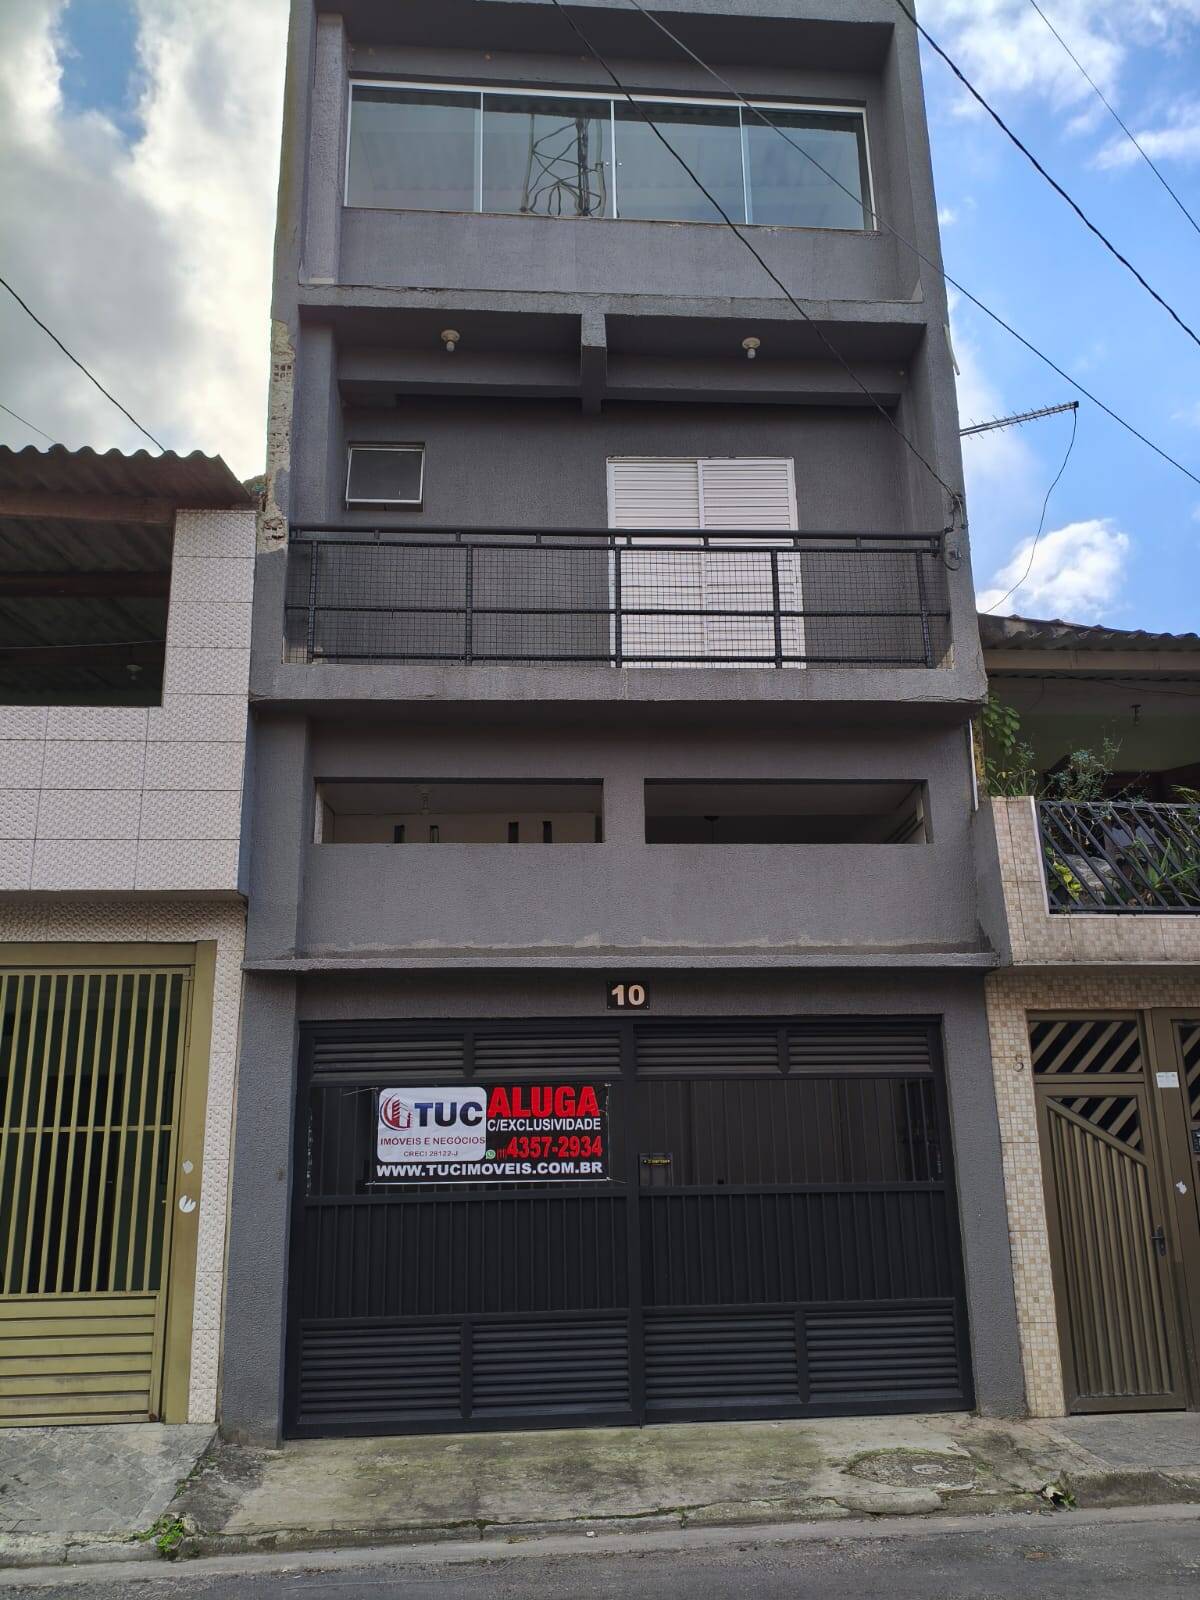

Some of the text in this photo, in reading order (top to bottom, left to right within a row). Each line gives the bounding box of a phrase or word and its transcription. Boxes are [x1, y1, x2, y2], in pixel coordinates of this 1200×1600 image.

[611, 984, 645, 1006] 10
[487, 1086, 600, 1118] ALUGA
[414, 1101, 483, 1127] TUC
[487, 1117, 601, 1132] C/EXCLUSIVIDADE
[424, 1137, 431, 1145] E
[507, 1136, 603, 1159] 4357-2934
[376, 1161, 603, 1177] WWW.TUCIMOVEIS.COM.BR
